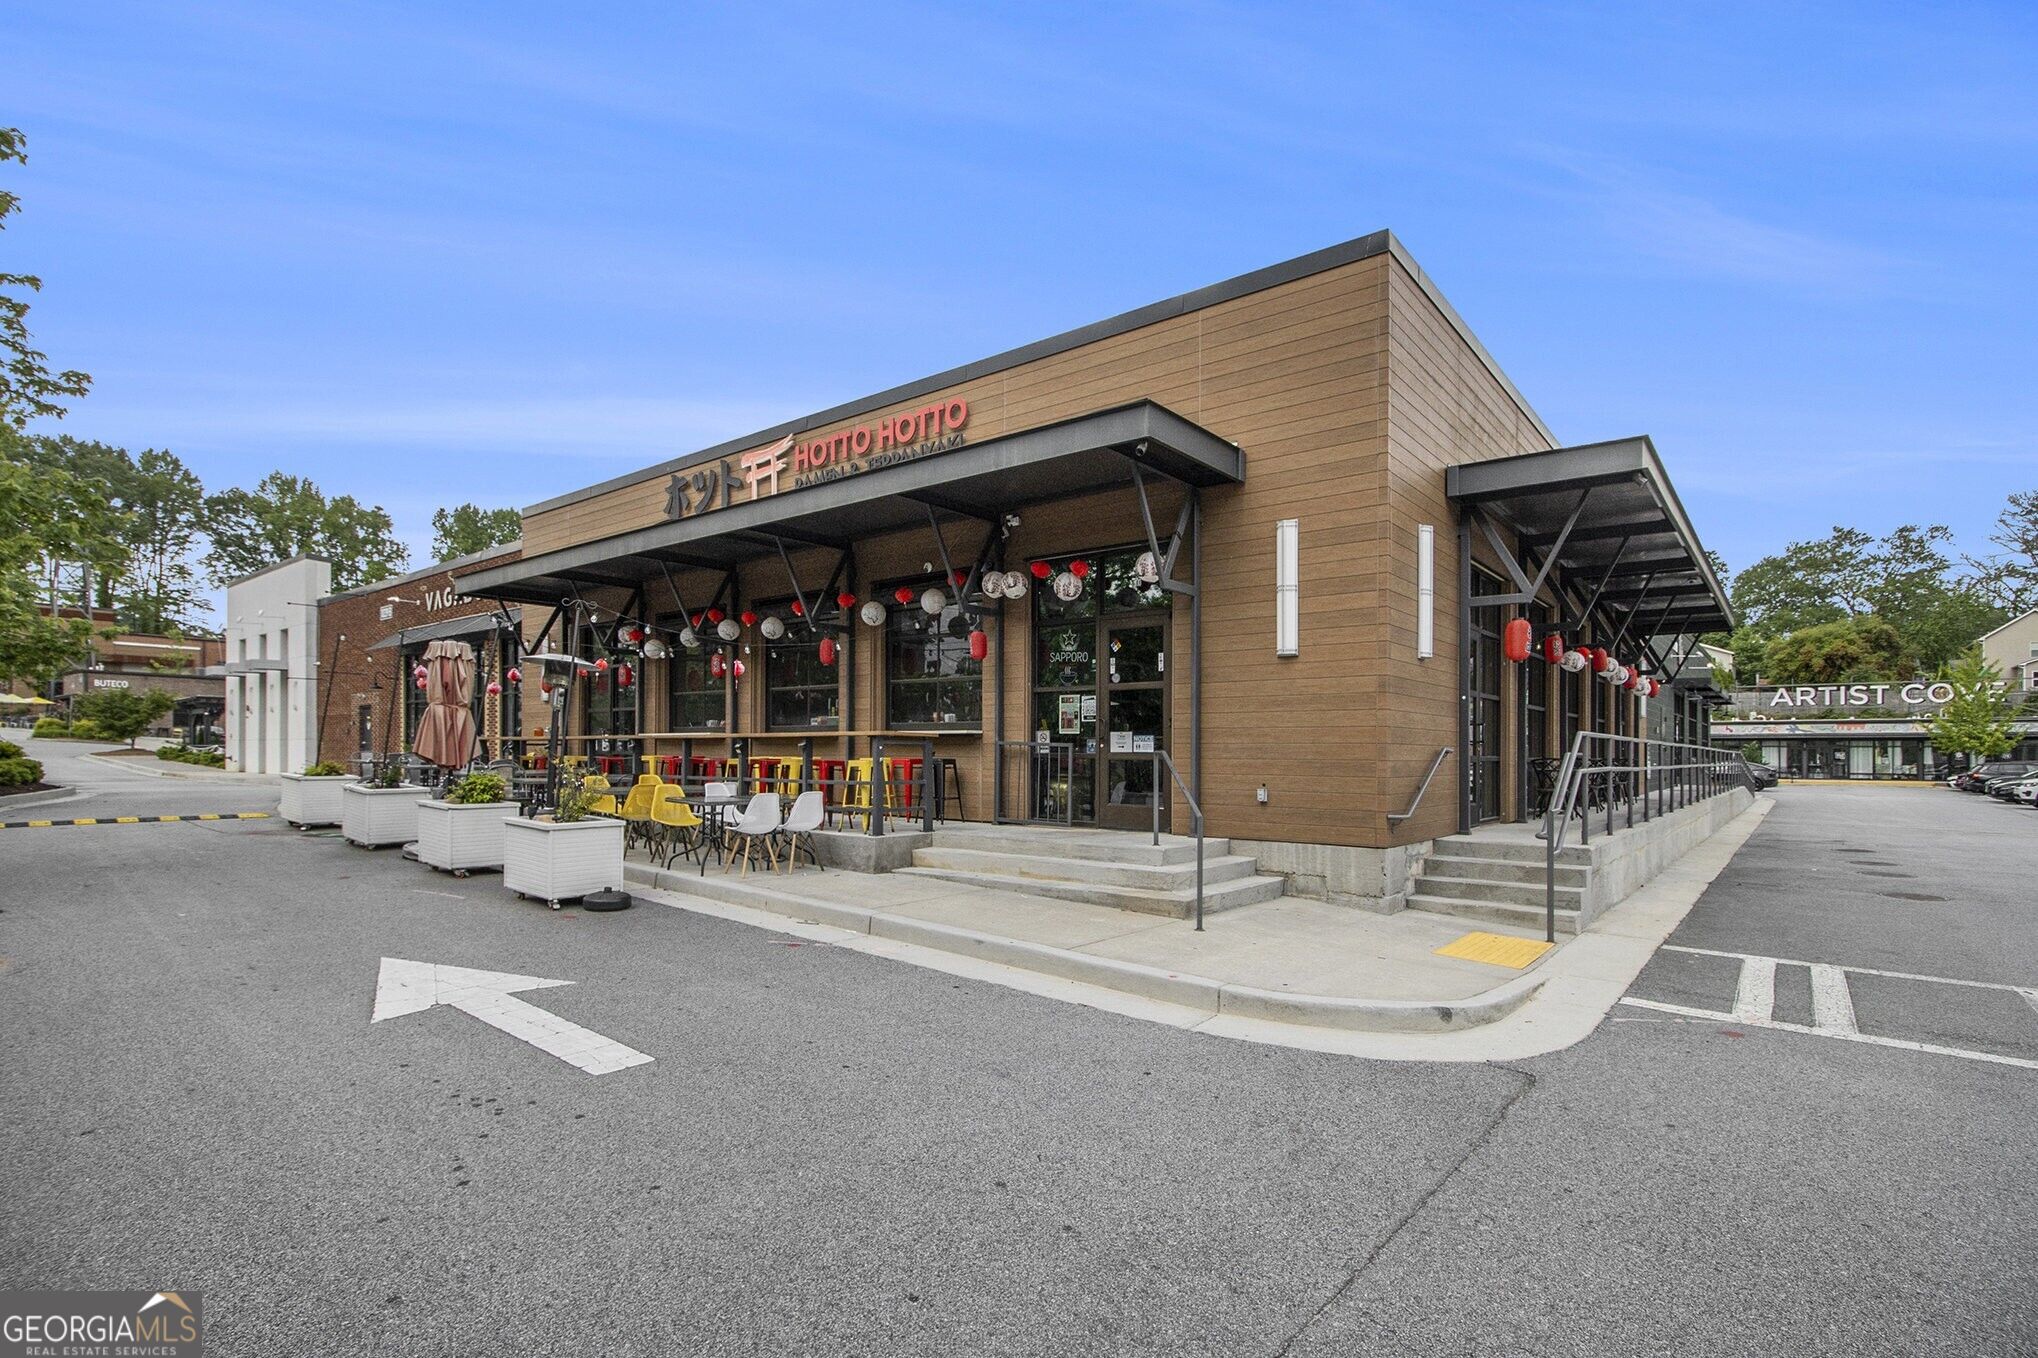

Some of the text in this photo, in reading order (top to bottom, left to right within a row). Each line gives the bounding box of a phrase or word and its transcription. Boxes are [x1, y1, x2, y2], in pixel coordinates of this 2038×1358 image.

[794, 397, 968, 472] HOTTO HOTTO
[1049, 651, 1089, 663] SAPPORO
[94, 679, 129, 688] BUTECO
[1770, 684, 1890, 706] ARTIST
